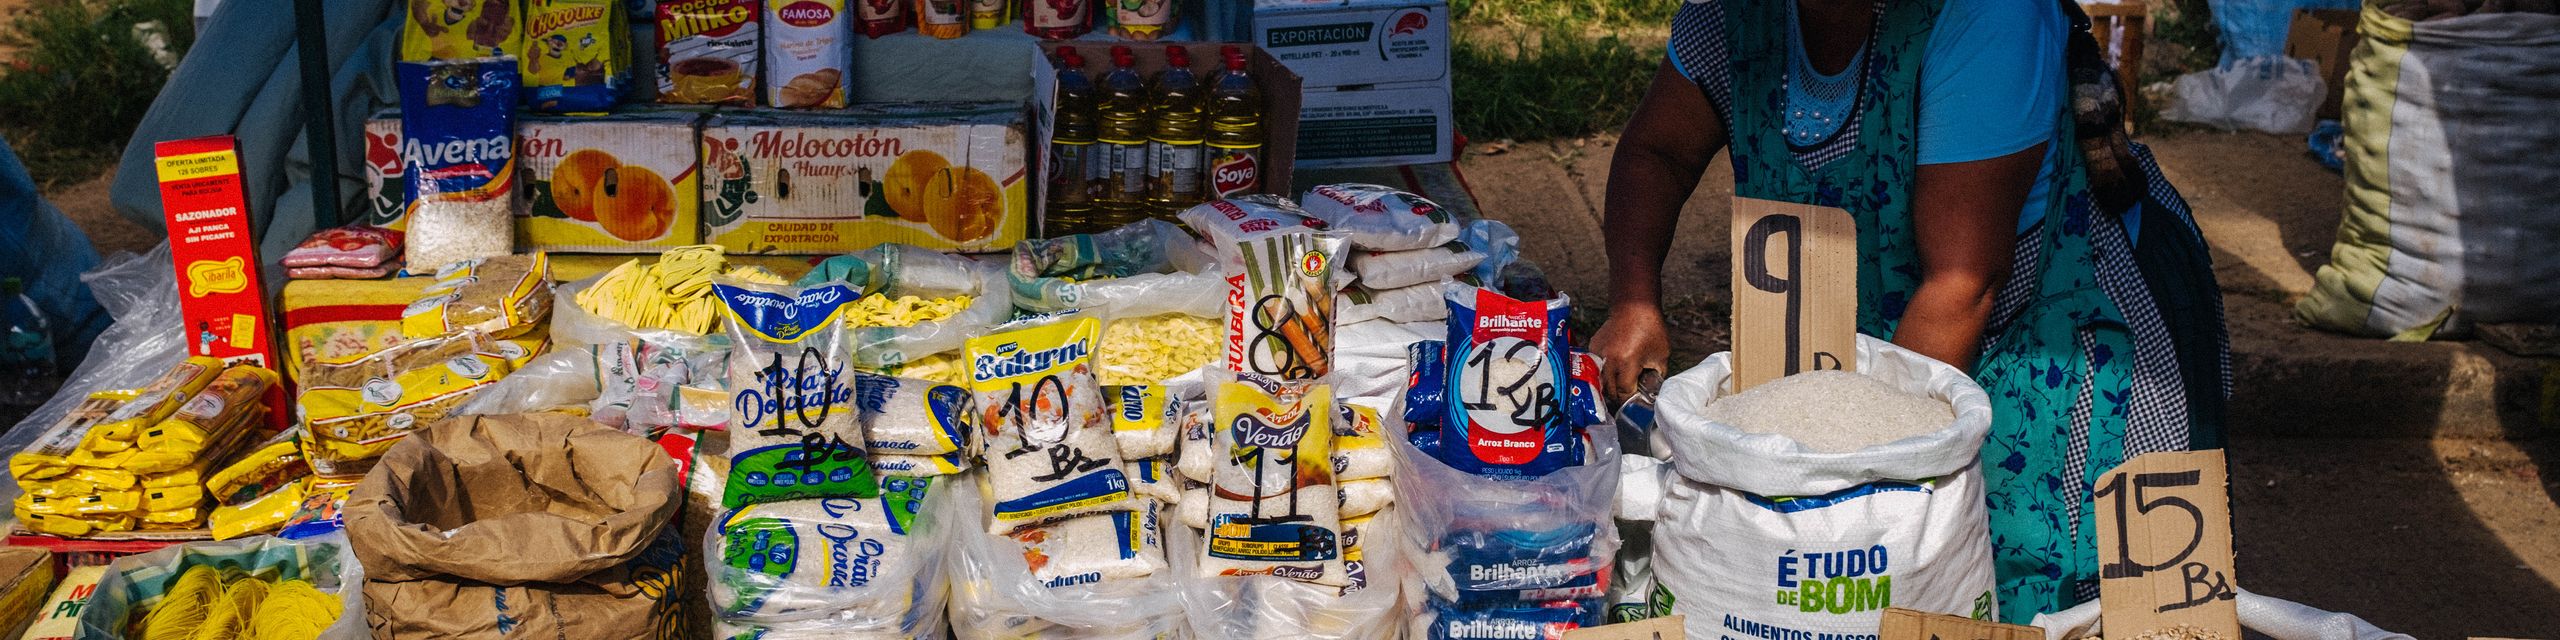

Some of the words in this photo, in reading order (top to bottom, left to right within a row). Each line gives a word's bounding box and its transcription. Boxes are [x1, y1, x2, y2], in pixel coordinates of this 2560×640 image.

[661, 5, 749, 42] Milko
[782, 8, 832, 20] FAMOSA
[1271, 26, 1366, 45] EXPORTACIÓN
[402, 135, 512, 170] Avena
[753, 129, 905, 160] Melocotón
[166, 157, 193, 167] OFERTA
[194, 155, 226, 165] LIMITADA
[190, 165, 218, 175] SOBRES
[1217, 164, 1254, 187] Soya
[175, 206, 237, 223] SAZONADOR
[185, 236, 200, 244] SIN
[200, 231, 236, 242] PICANTE
[188, 227, 201, 235] AJI
[202, 223, 230, 232] PANCA
[764, 232, 840, 244] EXPORTACIÓN
[768, 223, 818, 232] CALIDAD
[821, 223, 834, 232] DE
[1743, 213, 1802, 377] 9
[1479, 315, 1542, 328] Brilhante
[1249, 294, 1295, 375] 8
[754, 346, 832, 438] 10
[999, 374, 1069, 460] 10
[1266, 400, 1301, 424] Arroz
[1236, 415, 1306, 447] Verão
[1478, 438, 1502, 448] Arroz
[1504, 438, 1536, 448] Branco
[1231, 443, 1315, 525] 11
[2093, 469, 2204, 579] 15
[1274, 566, 1324, 579] Verão
[1470, 563, 1560, 581] Brilhante
[1777, 549, 1798, 588] É
[1803, 544, 1888, 579] TUDO
[1776, 589, 1798, 606] DE
[1800, 574, 1891, 615] BOM
[2157, 561, 2237, 613] Bs
[1449, 620, 1537, 640] Brilhante
[1723, 613, 1812, 640] ALIMENTOS
